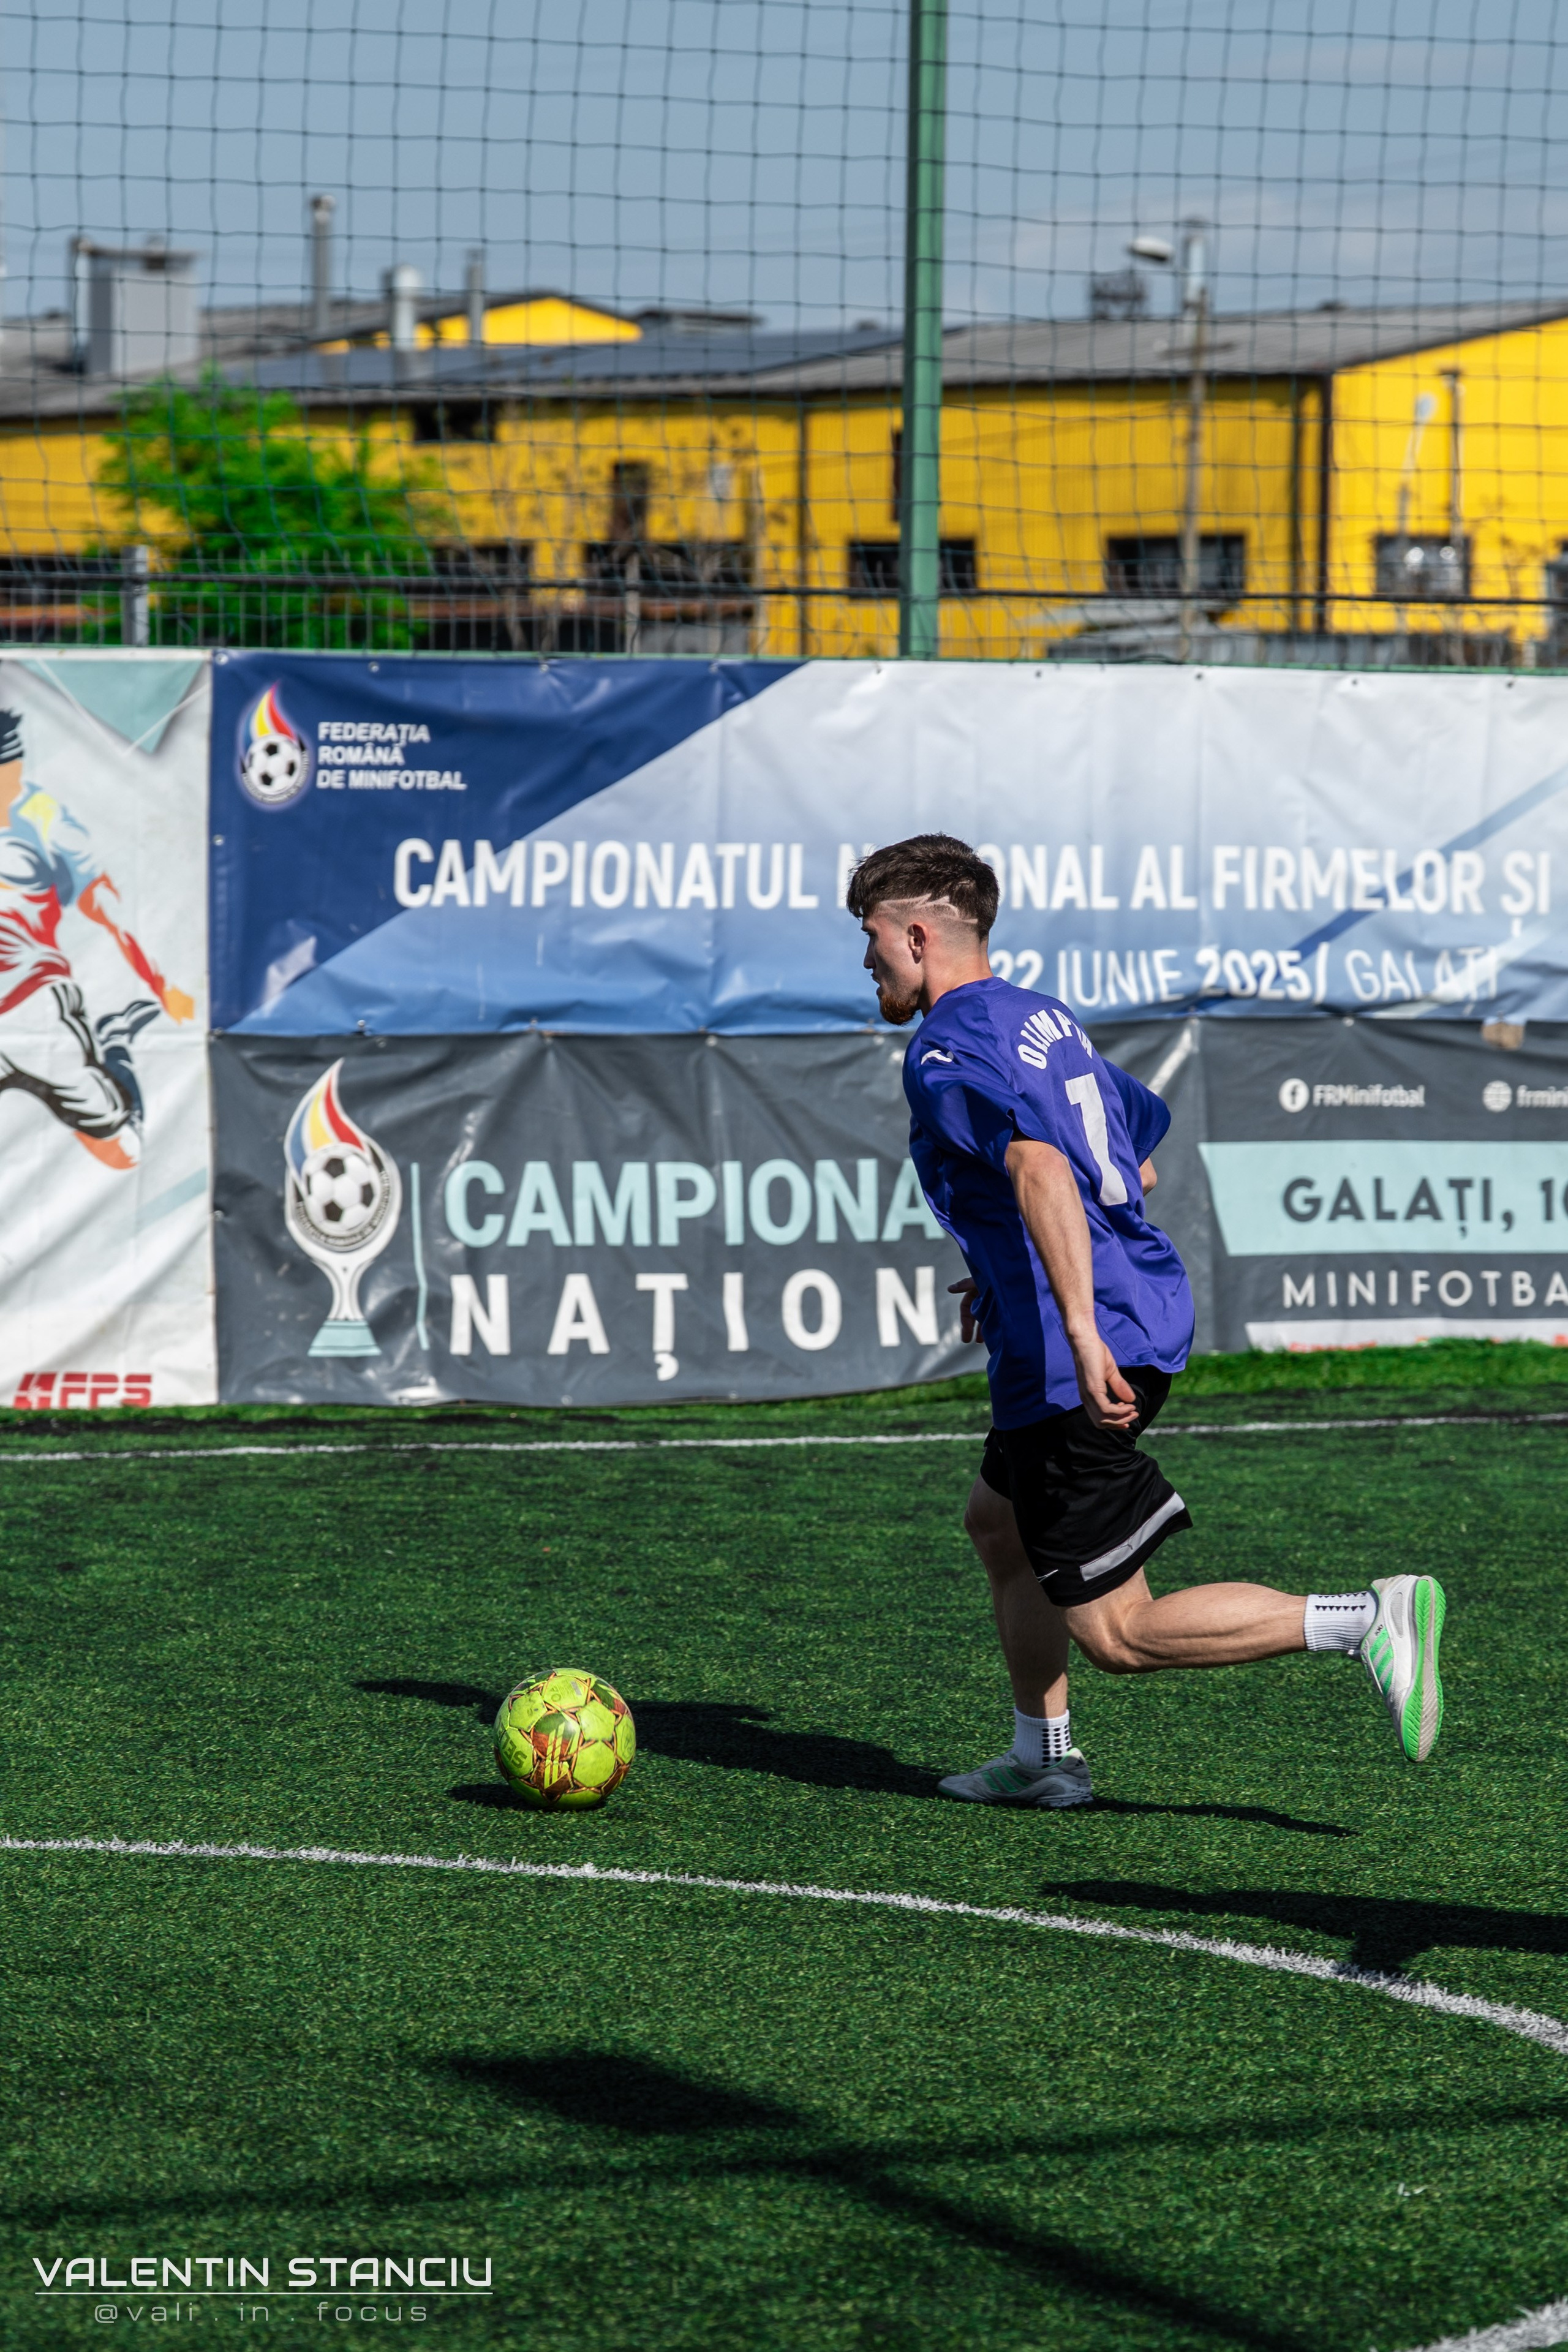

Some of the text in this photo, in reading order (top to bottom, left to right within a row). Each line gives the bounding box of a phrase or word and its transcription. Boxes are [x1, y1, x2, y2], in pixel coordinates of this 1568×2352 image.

[318, 722, 431, 747] FEDERAȚIA
[318, 742, 405, 766] ROMÂNĂ
[316, 769, 346, 790] DE
[348, 769, 468, 790] MINIFOTBAL
[393, 838, 819, 910] CAMPIONATUL
[1130, 844, 1197, 911] AL
[1212, 845, 1486, 915] FIRMELOR
[1499, 850, 1551, 937] ȘI
[1057, 949, 1185, 1008] IUNIE
[1017, 1008, 1093, 1069] OLIMPIA
[1064, 1072, 1128, 1206] 1
[1283, 1176, 1568, 1239] GALAȚI, 1
